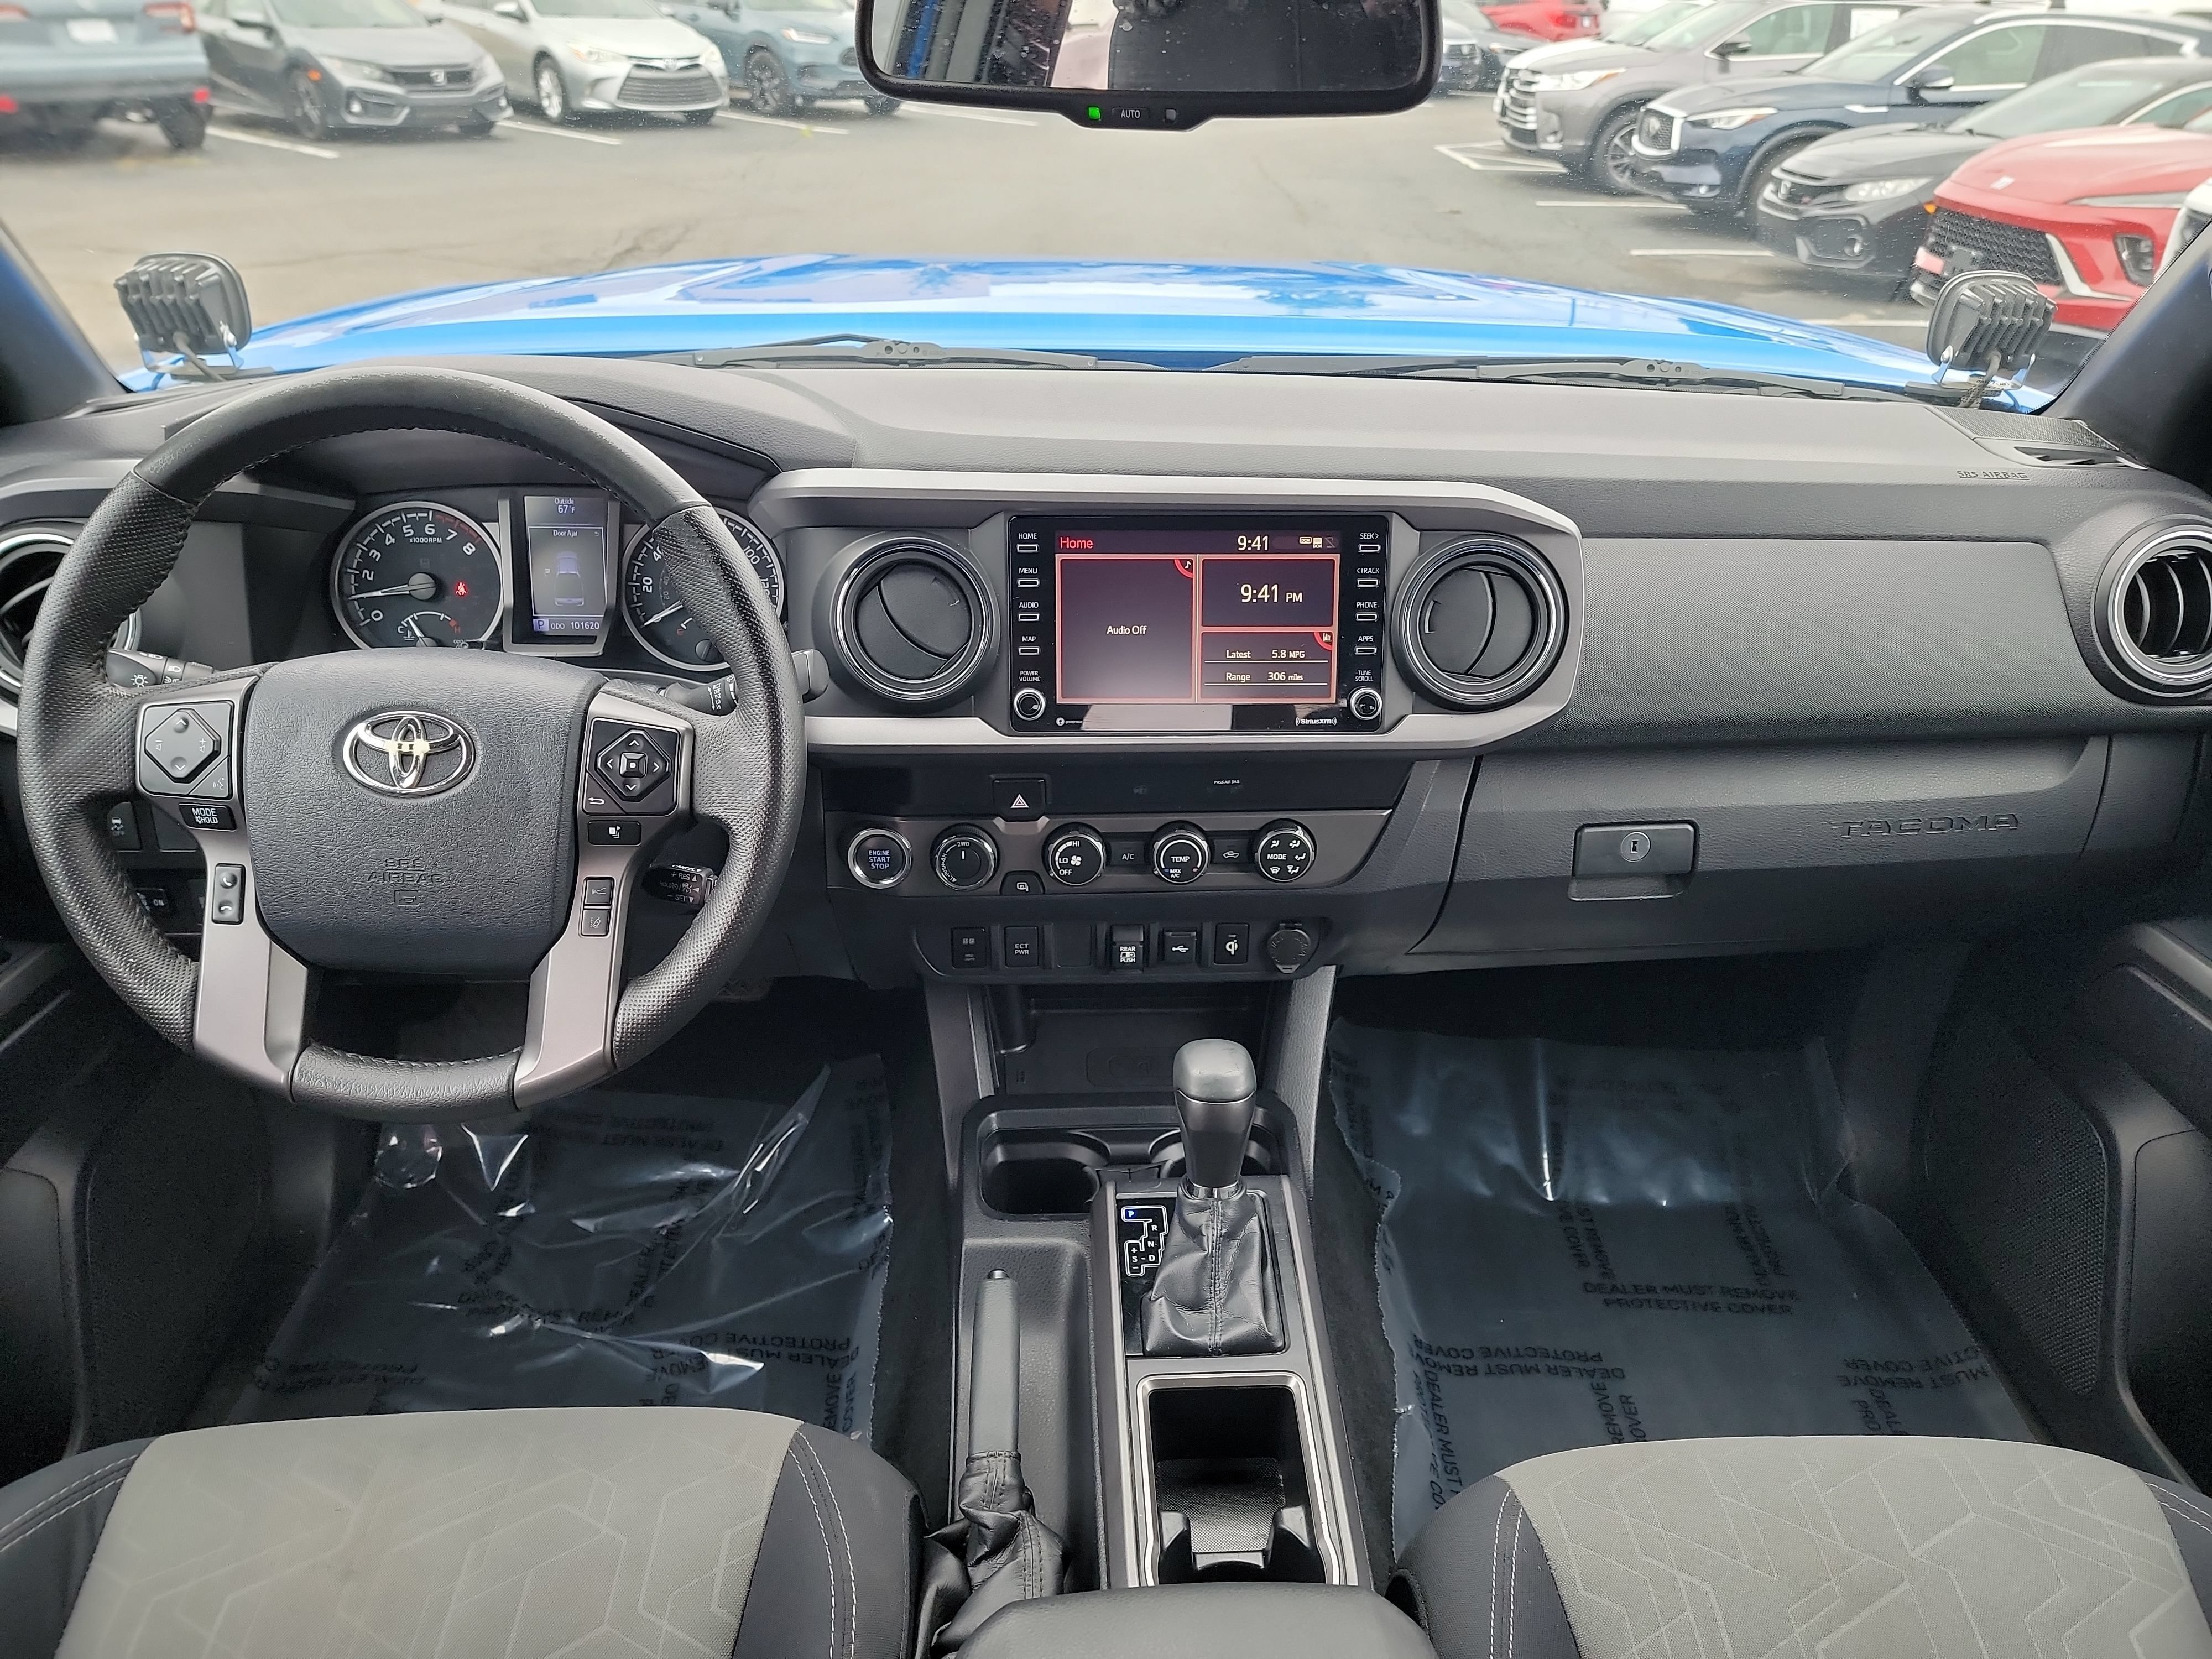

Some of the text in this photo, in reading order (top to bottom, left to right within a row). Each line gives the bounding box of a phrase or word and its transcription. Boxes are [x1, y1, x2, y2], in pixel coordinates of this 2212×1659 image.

[1120, 109, 1140, 118] AUTO
[401, 525, 414, 537] 5
[425, 523, 435, 535] 6
[445, 528, 458, 540] 7
[385, 533, 395, 546] 4
[1060, 535, 1269, 551] Home 9:41
[462, 542, 476, 555] 8
[368, 549, 382, 562] 3
[362, 569, 374, 581] 2
[642, 577, 653, 593] 20
[1240, 584, 1302, 603] 9:41 PM
[370, 609, 384, 622] 0
[537, 620, 545, 629] P
[570, 622, 600, 630] 101620
[1107, 625, 1147, 634] Audio Off
[1226, 649, 1305, 659] Latest 5.8 MPG
[1225, 672, 1251, 682] Range
[1267, 672, 1286, 681] 306
[192, 807, 217, 817] MODE
[1829, 813, 2019, 838] TACOMA
[367, 872, 446, 885] AIRBAG
[1583, 1281, 1799, 1302] DEALER MUST REMOVE
[1603, 1297, 1793, 1315] PROTECTIVE COVER
[726, 1332, 851, 1350] PROTECTIVE
[727, 1347, 781, 1360] MUS
[1479, 1345, 1603, 1363] PROTECTIVE
[1485, 1363, 1540, 1376] MUST
[1547, 1364, 1626, 1380] DEALER
[1842, 1358, 1914, 1374] COVER
[1836, 1374, 1924, 1390] REMOVE
[1618, 1394, 1648, 1443] OVER
[1423, 1368, 1451, 1436] DEALER
[1438, 1437, 1464, 1488] MUST
